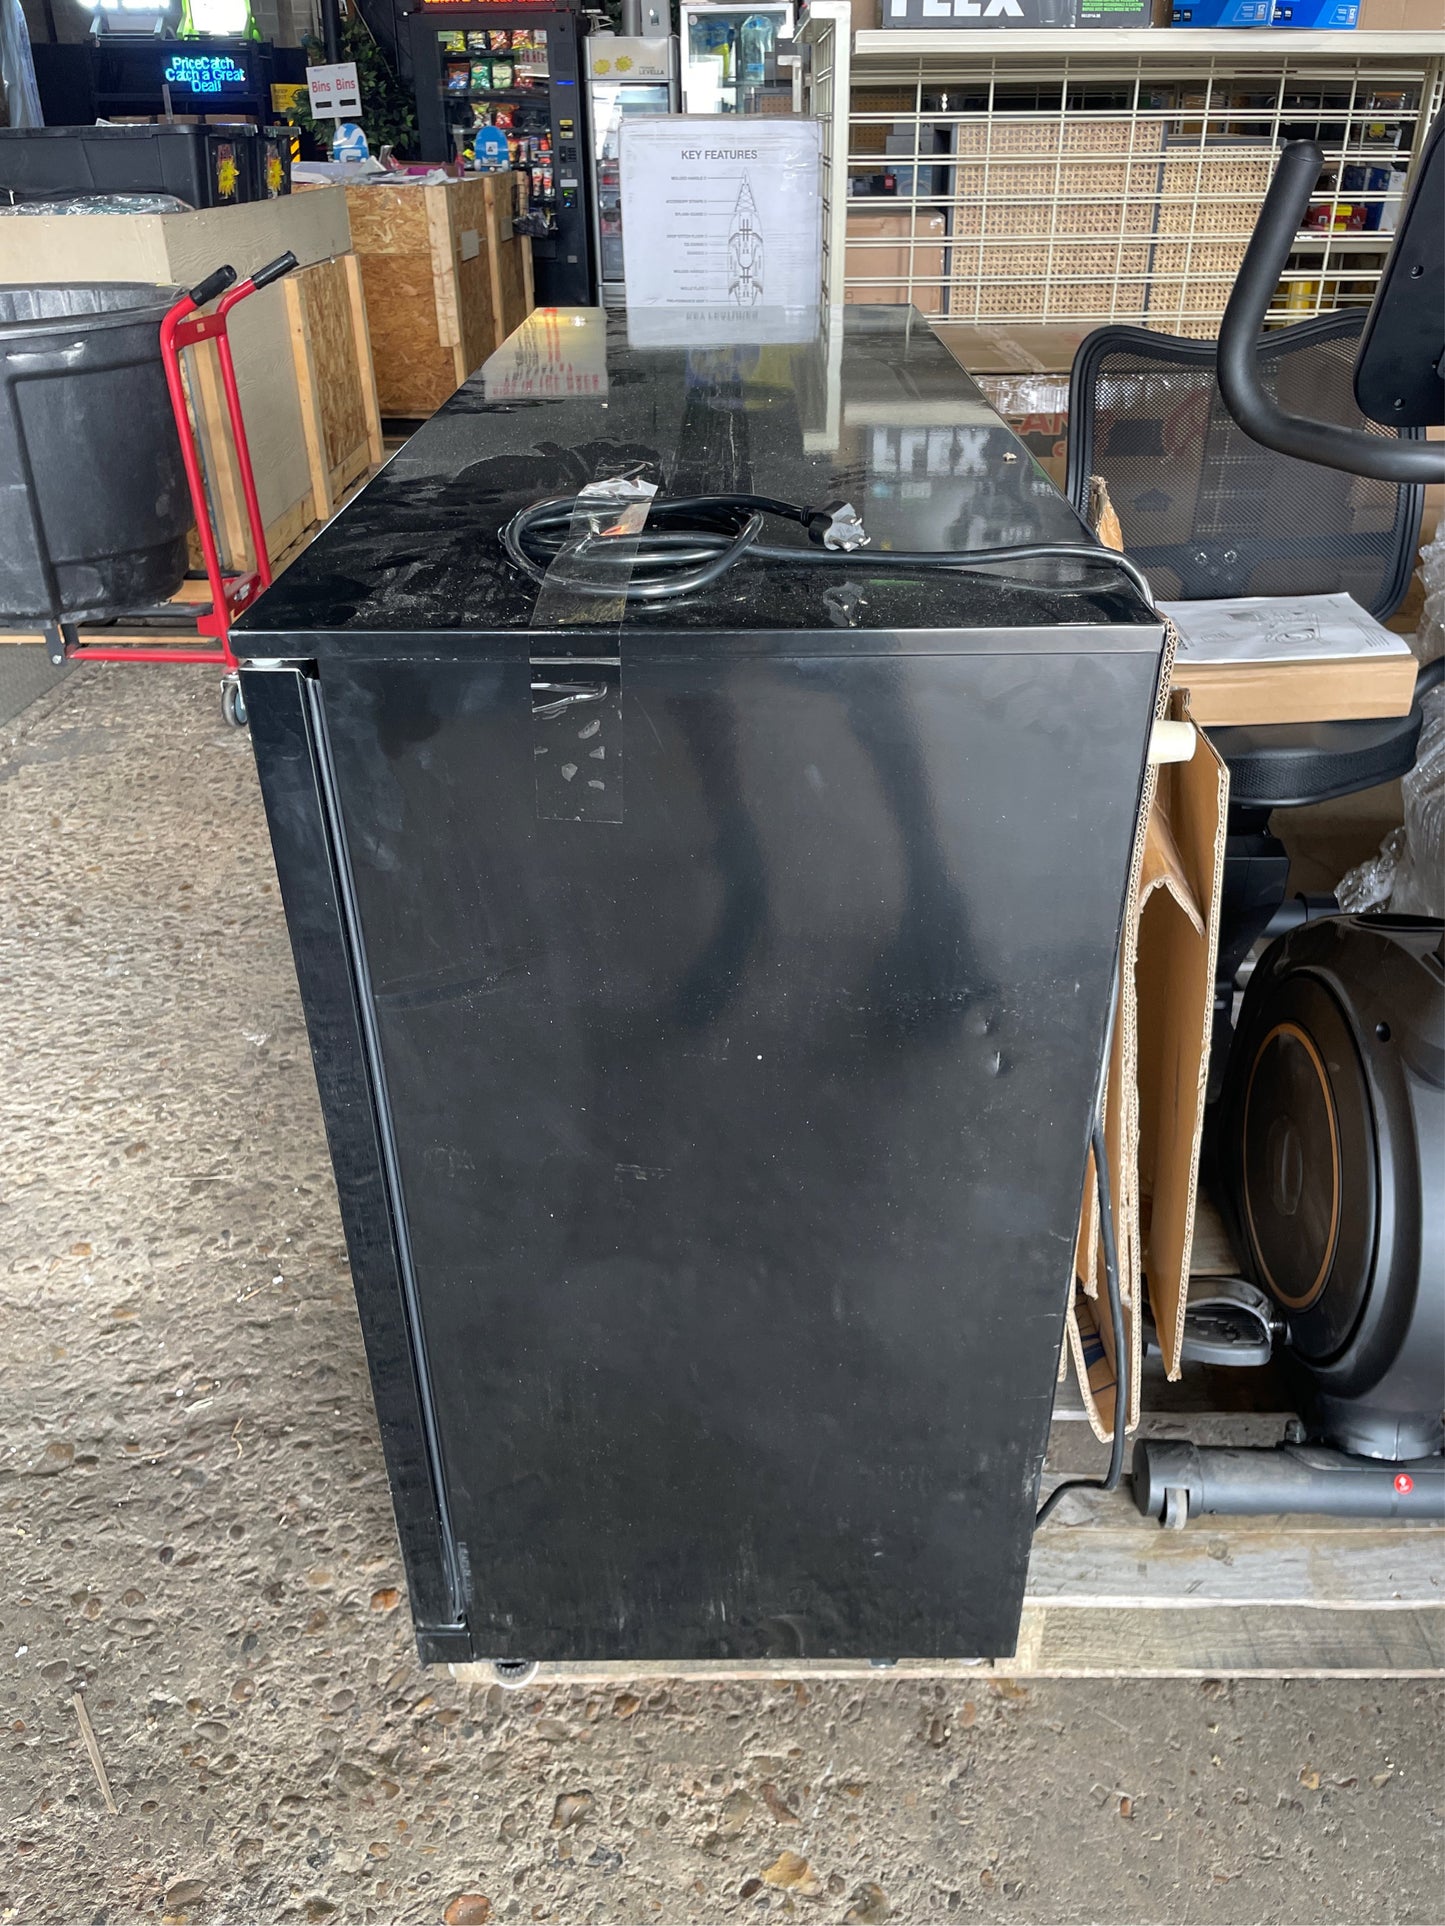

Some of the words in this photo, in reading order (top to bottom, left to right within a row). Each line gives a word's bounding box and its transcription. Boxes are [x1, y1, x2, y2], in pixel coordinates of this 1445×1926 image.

[171, 56, 235, 70] PriceCatch
[165, 68, 200, 82] Catch
[201, 70, 210, 81] a
[212, 68, 246, 82] Great
[191, 79, 222, 92] Deal!
[312, 80, 331, 93] Bins
[335, 77, 356, 91] Bins
[681, 150, 703, 160] KEY
[704, 149, 758, 160] FEATURES
